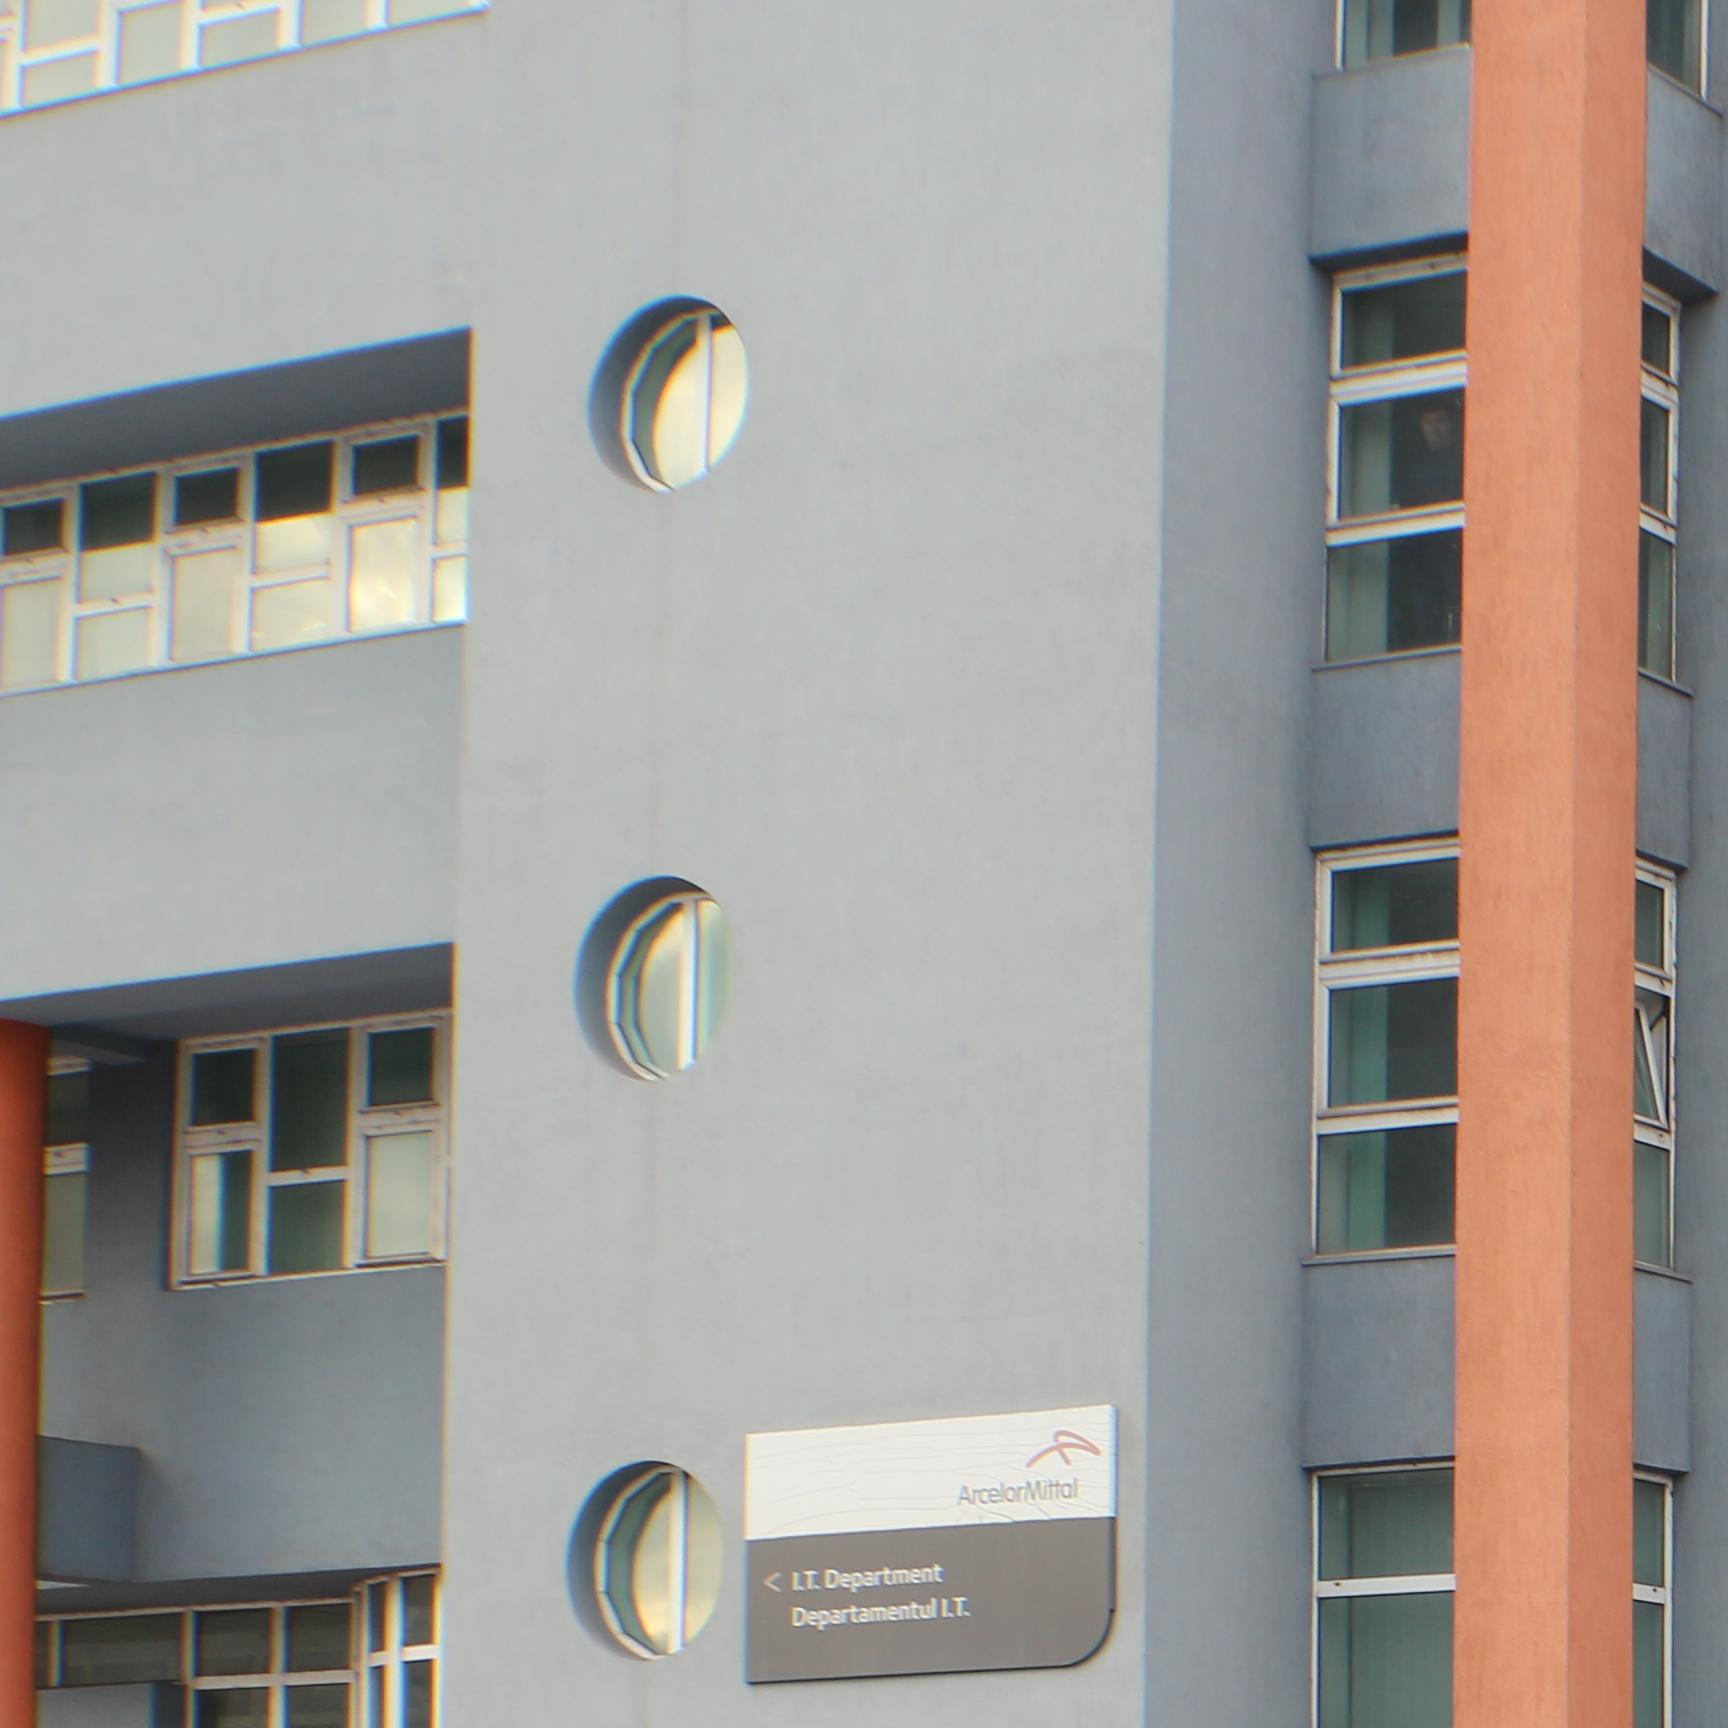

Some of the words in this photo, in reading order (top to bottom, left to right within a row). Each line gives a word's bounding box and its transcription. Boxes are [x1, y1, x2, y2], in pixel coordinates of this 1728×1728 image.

[956, 1477, 1078, 1506] ArcelorMittal
[792, 1569, 820, 1592] I.T.
[824, 1562, 944, 1594] Department
[792, 1598, 937, 1631] Departamentul
[941, 1596, 971, 1620] I.T.
